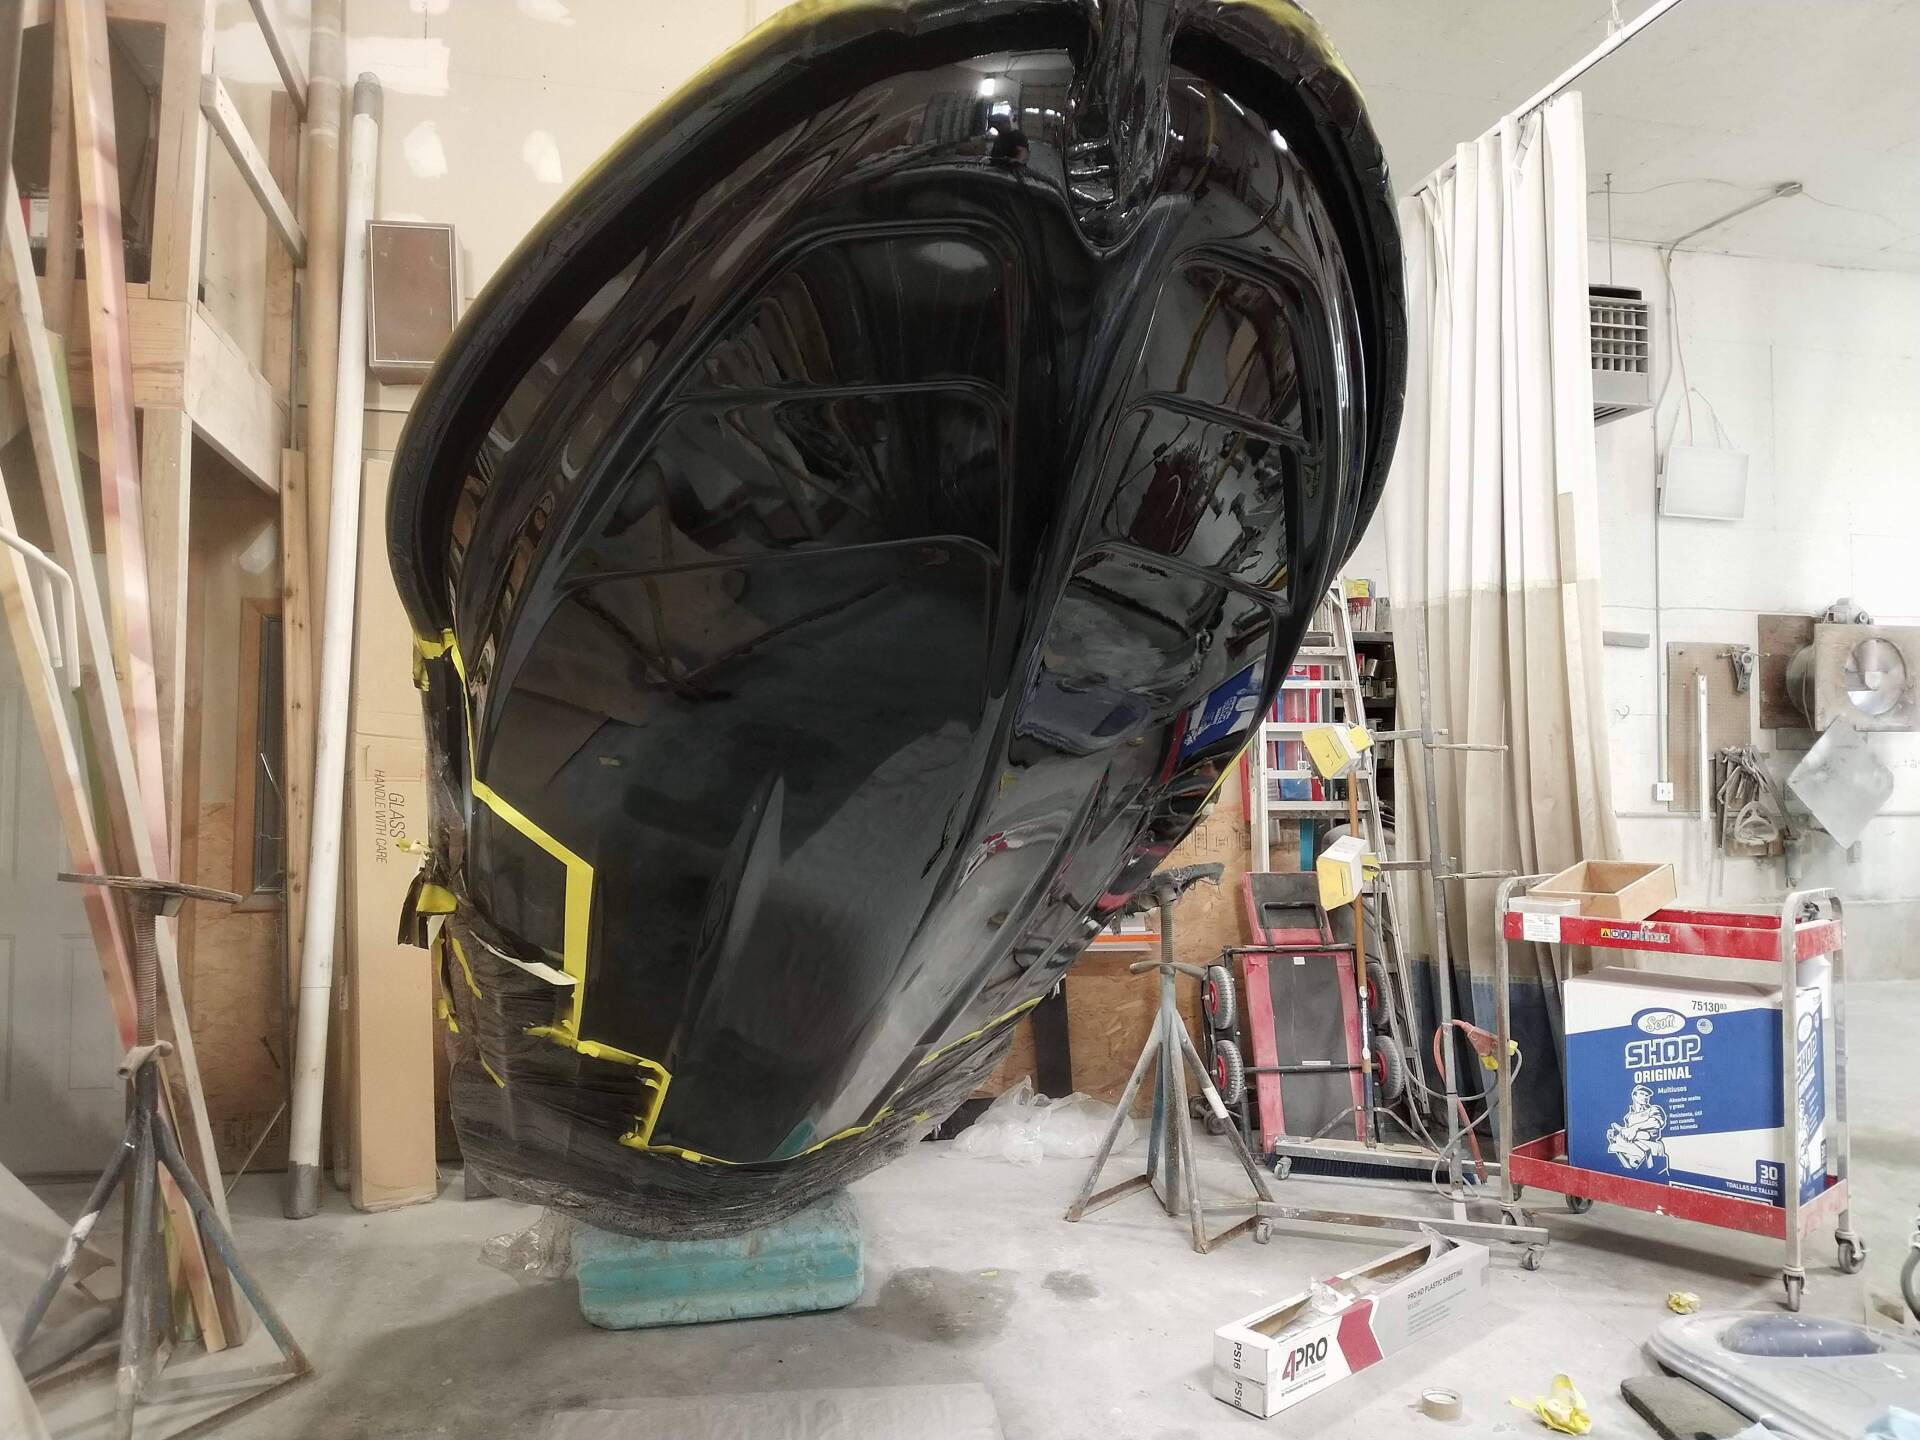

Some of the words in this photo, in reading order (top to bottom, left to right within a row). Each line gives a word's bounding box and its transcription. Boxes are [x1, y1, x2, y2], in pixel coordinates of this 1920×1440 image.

[374, 769, 386, 809] HANDLE
[375, 810, 387, 836] WITH
[389, 793, 406, 839] GLASS
[375, 837, 388, 864] CARE
[1646, 1014, 1676, 1032] Scott
[1625, 1034, 1702, 1068] SHOP
[1634, 1066, 1692, 1084] ORIGINAL
[1760, 1164, 1778, 1180] 30
[1726, 1181, 1750, 1191] TOALLAS
[1758, 1187, 1778, 1196] TALLER
[1233, 1342, 1242, 1370] PS16
[1234, 1380, 1243, 1408] PS16
